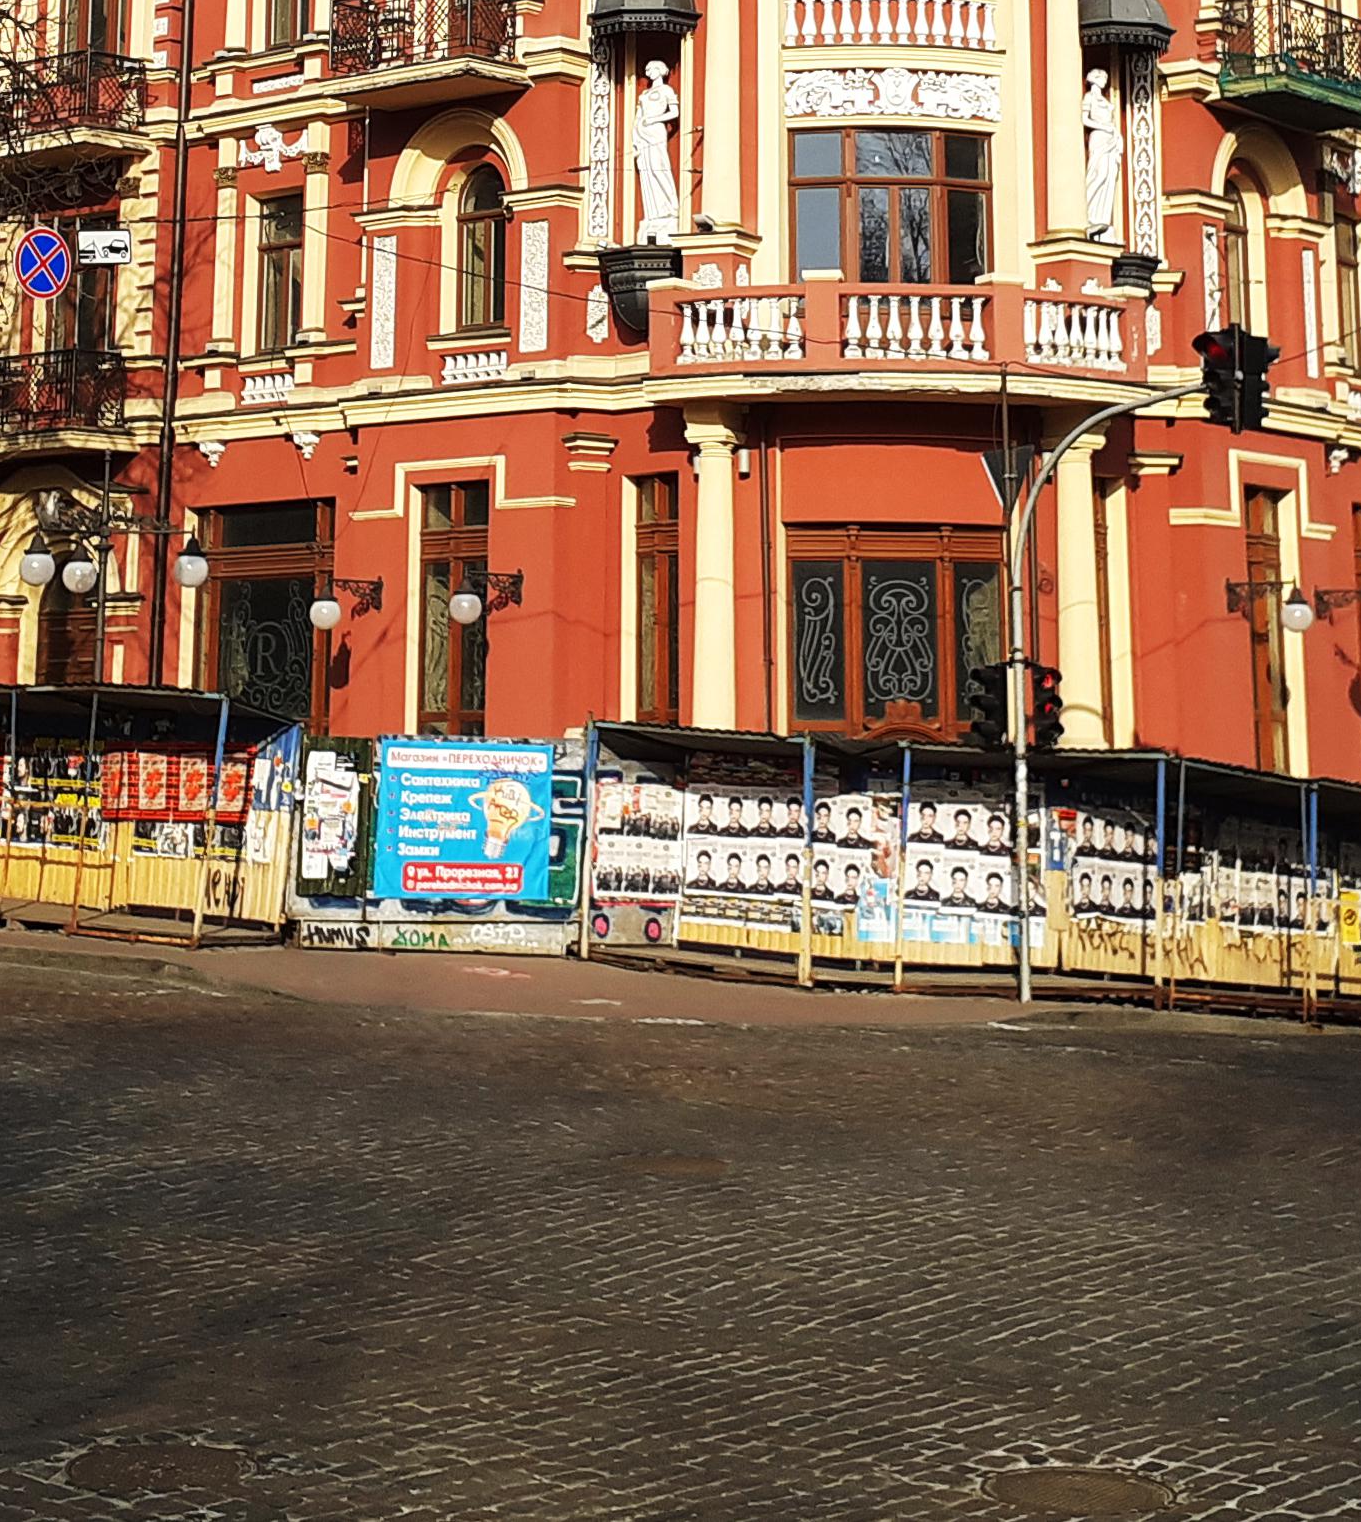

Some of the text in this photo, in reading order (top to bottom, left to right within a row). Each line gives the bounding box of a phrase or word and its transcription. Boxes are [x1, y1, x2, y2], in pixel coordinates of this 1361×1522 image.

[391, 751, 439, 763] Магазин
[400, 772, 480, 788] Сантехника
[400, 790, 452, 805] Крепеж
[399, 807, 471, 824] Электрика
[398, 825, 477, 841] Инструмент
[397, 842, 440, 856] Замки
